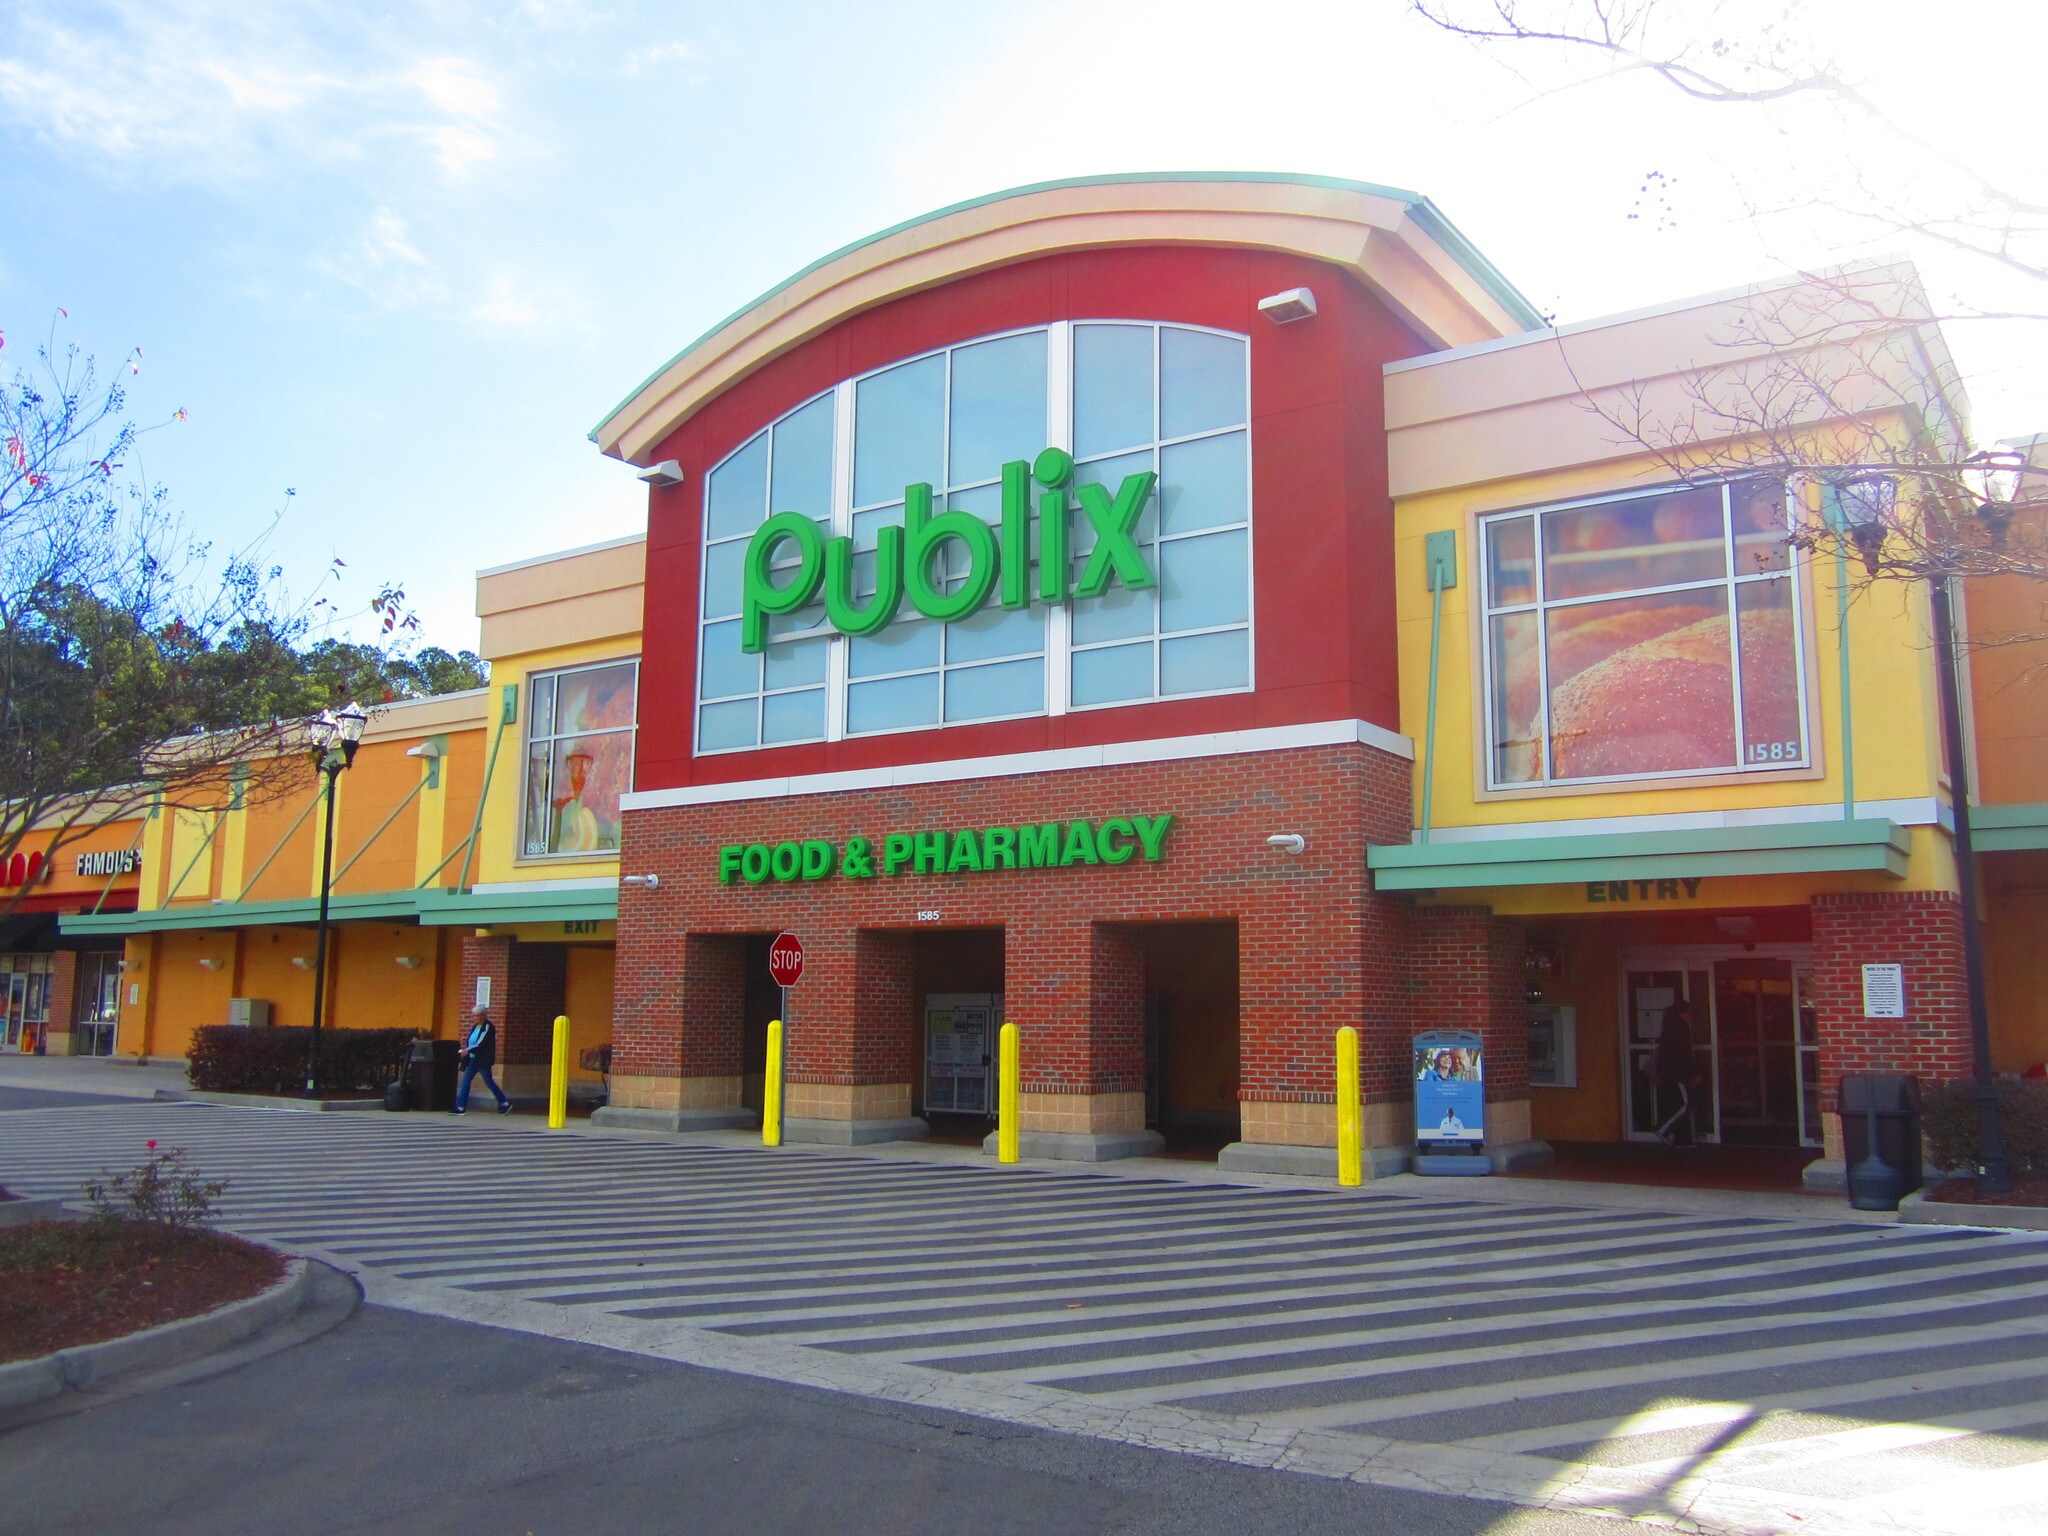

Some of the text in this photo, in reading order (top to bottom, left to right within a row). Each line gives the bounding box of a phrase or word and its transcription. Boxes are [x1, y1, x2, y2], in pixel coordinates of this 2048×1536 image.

[1748, 741, 1798, 761] 1585
[527, 842, 546, 853] 1585
[719, 814, 1172, 884] FOOD & PHARMACY
[76, 849, 134, 876] FAMOUS
[1587, 878, 1701, 902] ENTRY
[916, 911, 940, 921] 1585
[564, 920, 598, 934] EXIT
[773, 950, 801, 970] STOP
